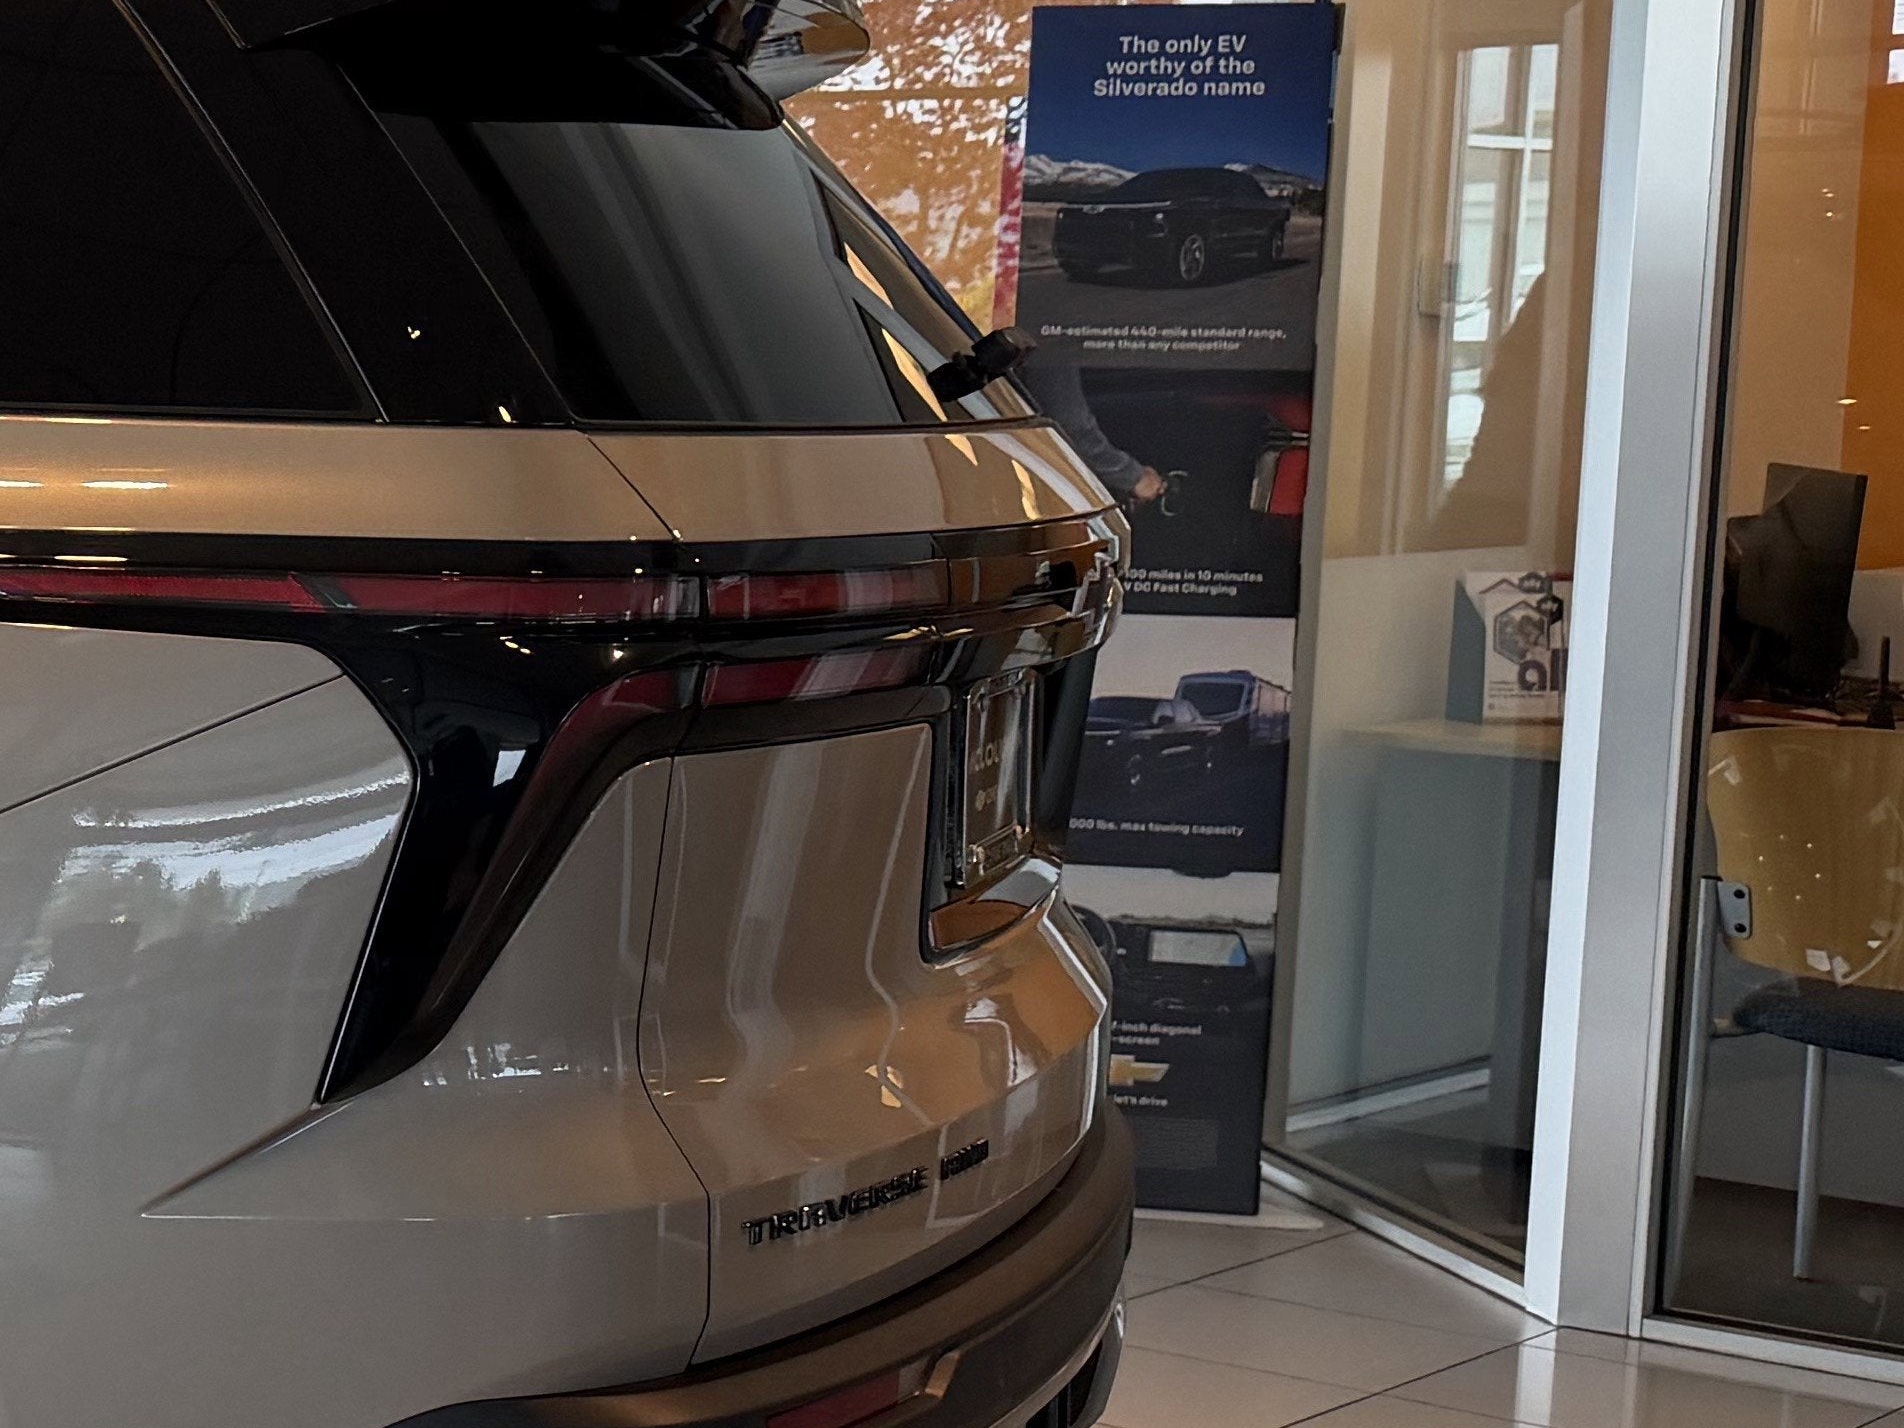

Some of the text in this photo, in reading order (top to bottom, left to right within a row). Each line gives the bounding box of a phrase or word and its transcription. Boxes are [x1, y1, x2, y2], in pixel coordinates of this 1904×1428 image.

[1119, 34, 1247, 57] The only EV
[1106, 55, 1256, 78] worthy of the
[1093, 77, 1266, 97] Silverado name
[1040, 325, 1129, 338] GM-estimated
[1191, 326, 1245, 338] standard
[1247, 329, 1287, 340] range,
[1083, 339, 1240, 352] more than any competitor
[1149, 570, 1182, 582] miles
[1198, 570, 1212, 582] 10
[1213, 570, 1264, 583] minutes
[1153, 583, 1180, 594] Fast
[1182, 583, 1238, 597] Charging
[1148, 821, 1190, 836] towing
[1192, 824, 1244, 837] capacity
[742, 1165, 929, 1247] TRAVERSE
